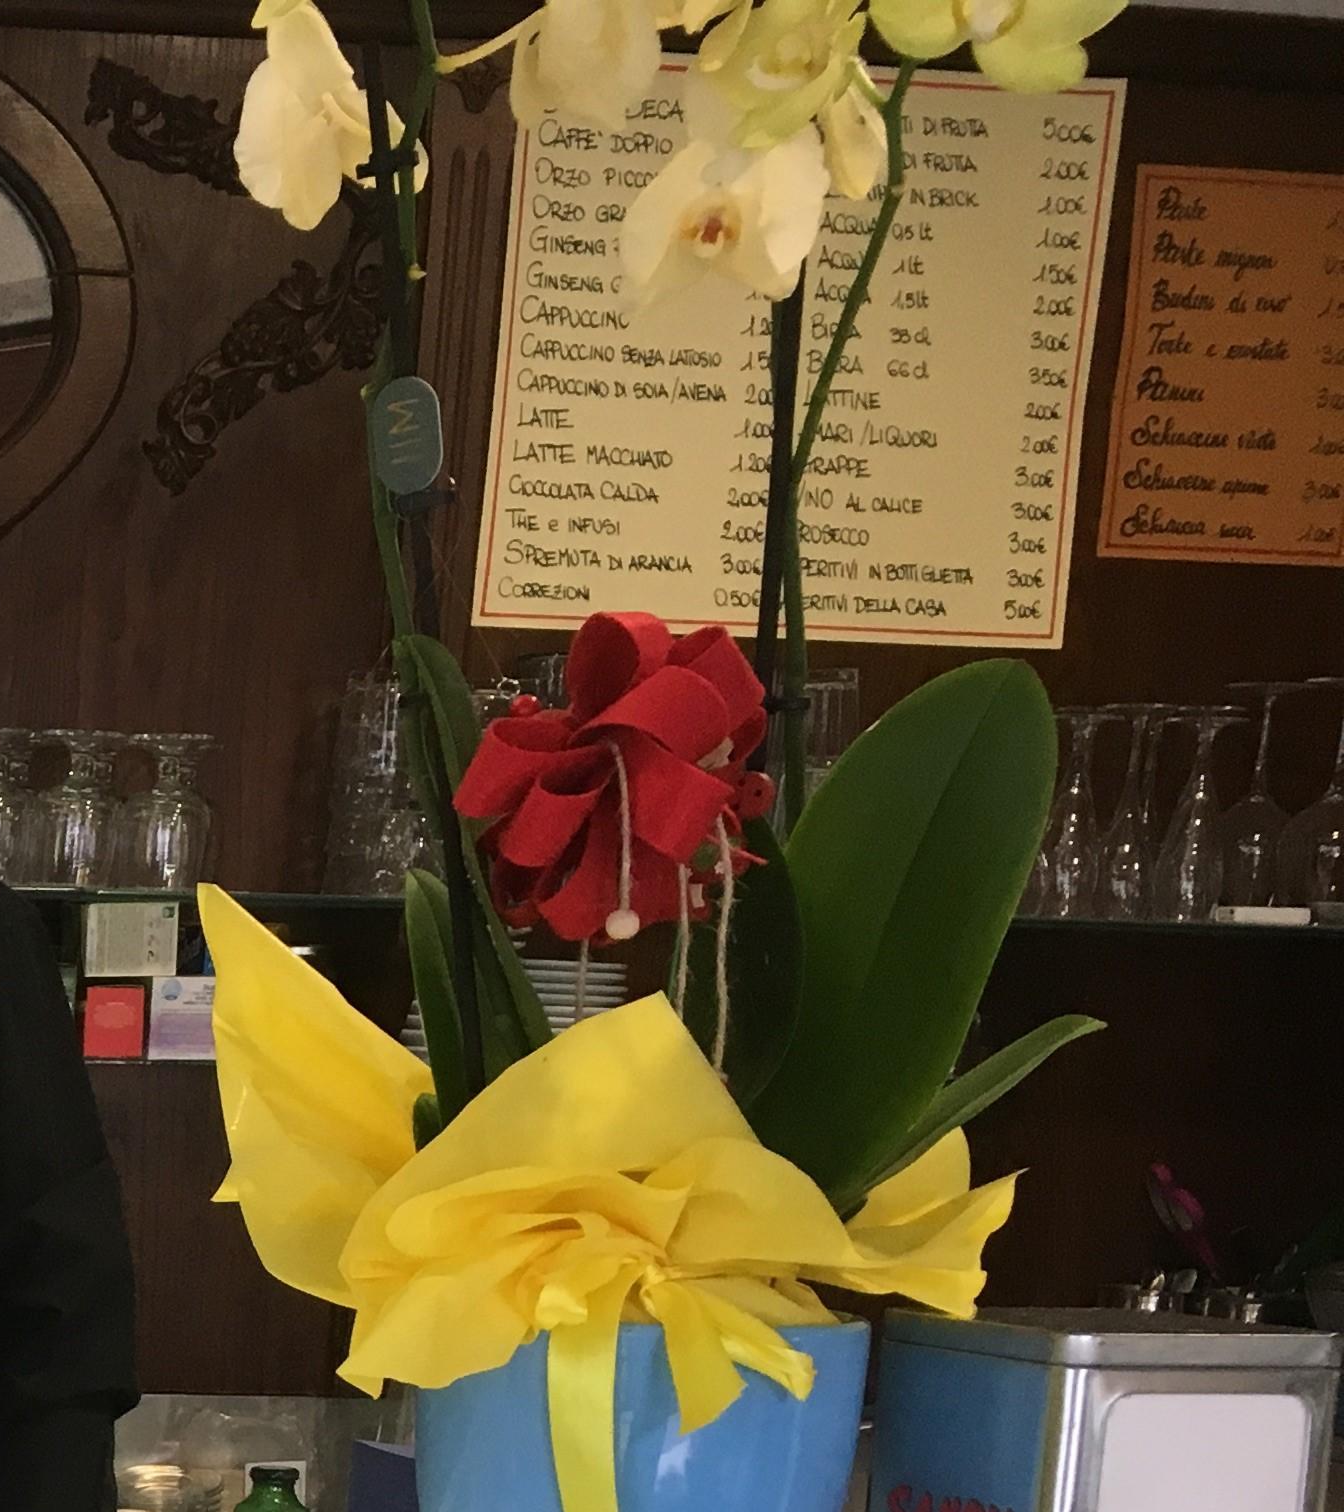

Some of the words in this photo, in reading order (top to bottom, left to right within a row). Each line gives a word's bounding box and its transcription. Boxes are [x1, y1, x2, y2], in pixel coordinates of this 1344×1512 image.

[611, 133, 673, 155] DOPPIO
[534, 157, 591, 189] ORZO
[532, 194, 586, 223] ORZO
[928, 188, 980, 208] BRICK
[528, 225, 606, 257] GINSENG
[817, 245, 865, 270] ACQU
[526, 261, 604, 294] GINSENG
[815, 277, 872, 305] ACQA
[520, 332, 614, 363] CAPPUCCINO
[621, 346, 663, 368] SENZA
[517, 368, 610, 398] CAPPUCCINO
[887, 359, 910, 379] 66
[802, 379, 882, 410] LTTINE
[517, 402, 575, 430] LATTE
[798, 423, 854, 445] MARI
[512, 438, 577, 465] LATTE
[586, 445, 673, 470] MACCHIATO
[508, 474, 595, 501] CIOCCOLATA
[600, 480, 660, 504] CALDA
[845, 492, 866, 513] AL
[871, 498, 923, 514] CALICE
[505, 508, 540, 532] THE
[568, 518, 620, 535] INFUSI
[503, 539, 602, 568] SPREMUTA
[628, 555, 692, 573] ARANCIA
[799, 556, 858, 580] PERITIVI
[498, 576, 590, 602] CORREZIONI
[800, 594, 848, 613] ERITIVI
[853, 596, 901, 615] DELLA
[905, 598, 947, 617] CASA
